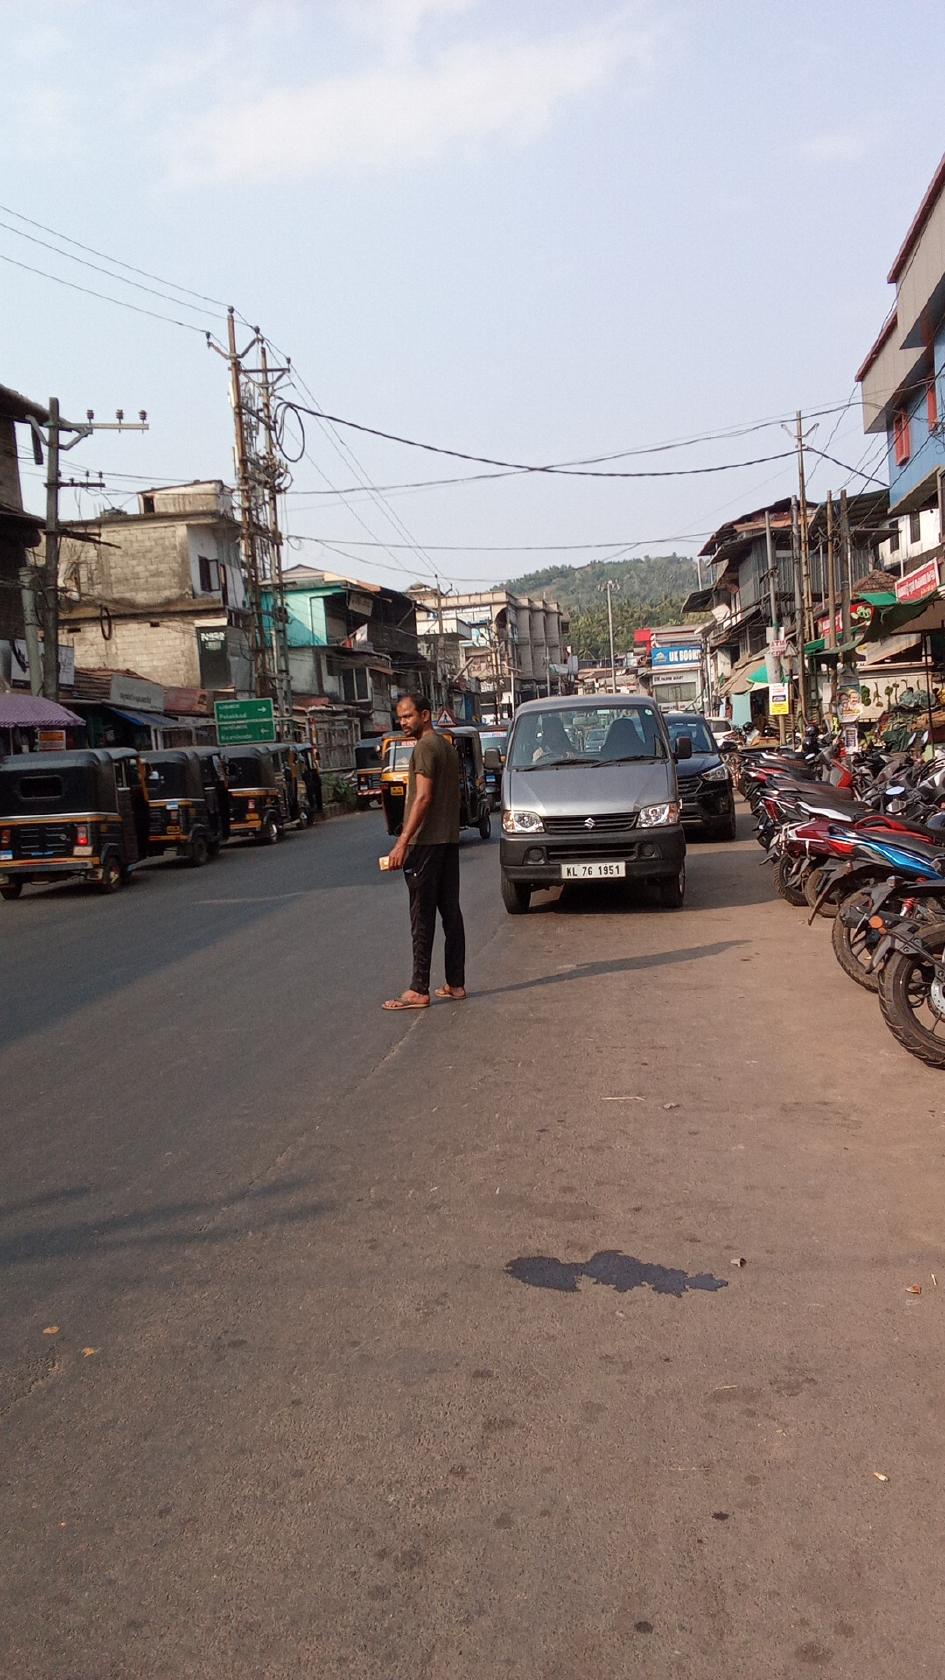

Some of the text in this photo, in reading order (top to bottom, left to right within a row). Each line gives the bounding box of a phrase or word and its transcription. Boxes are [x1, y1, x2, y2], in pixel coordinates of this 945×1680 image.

[566, 865, 620, 877] KL 76 1951
